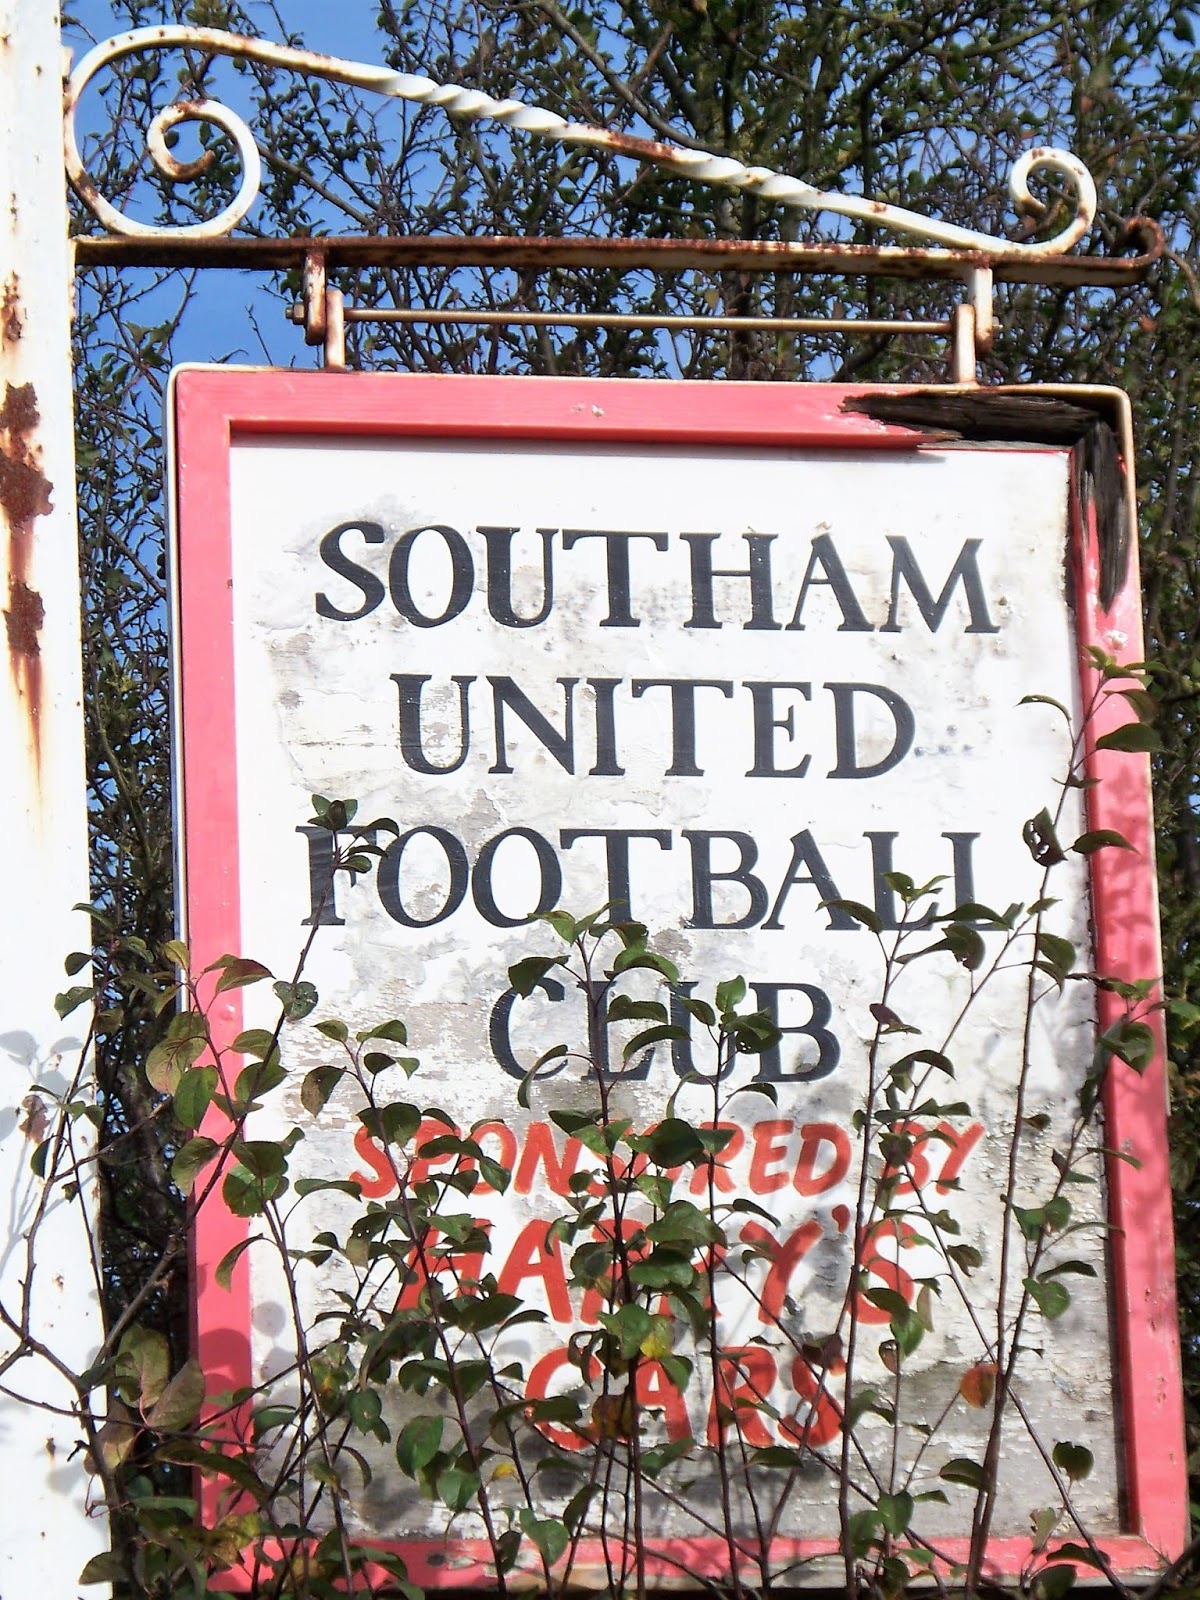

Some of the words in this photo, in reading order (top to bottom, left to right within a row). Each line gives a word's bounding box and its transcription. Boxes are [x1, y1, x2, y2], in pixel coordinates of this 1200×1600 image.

[315, 520, 1001, 634] SOUTHAM
[390, 673, 916, 780] UNITED
[295, 824, 1020, 932] FOOTBALL
[489, 977, 841, 1085] CLUB
[880, 1120, 985, 1197] BY
[524, 1345, 847, 1451] CARS
